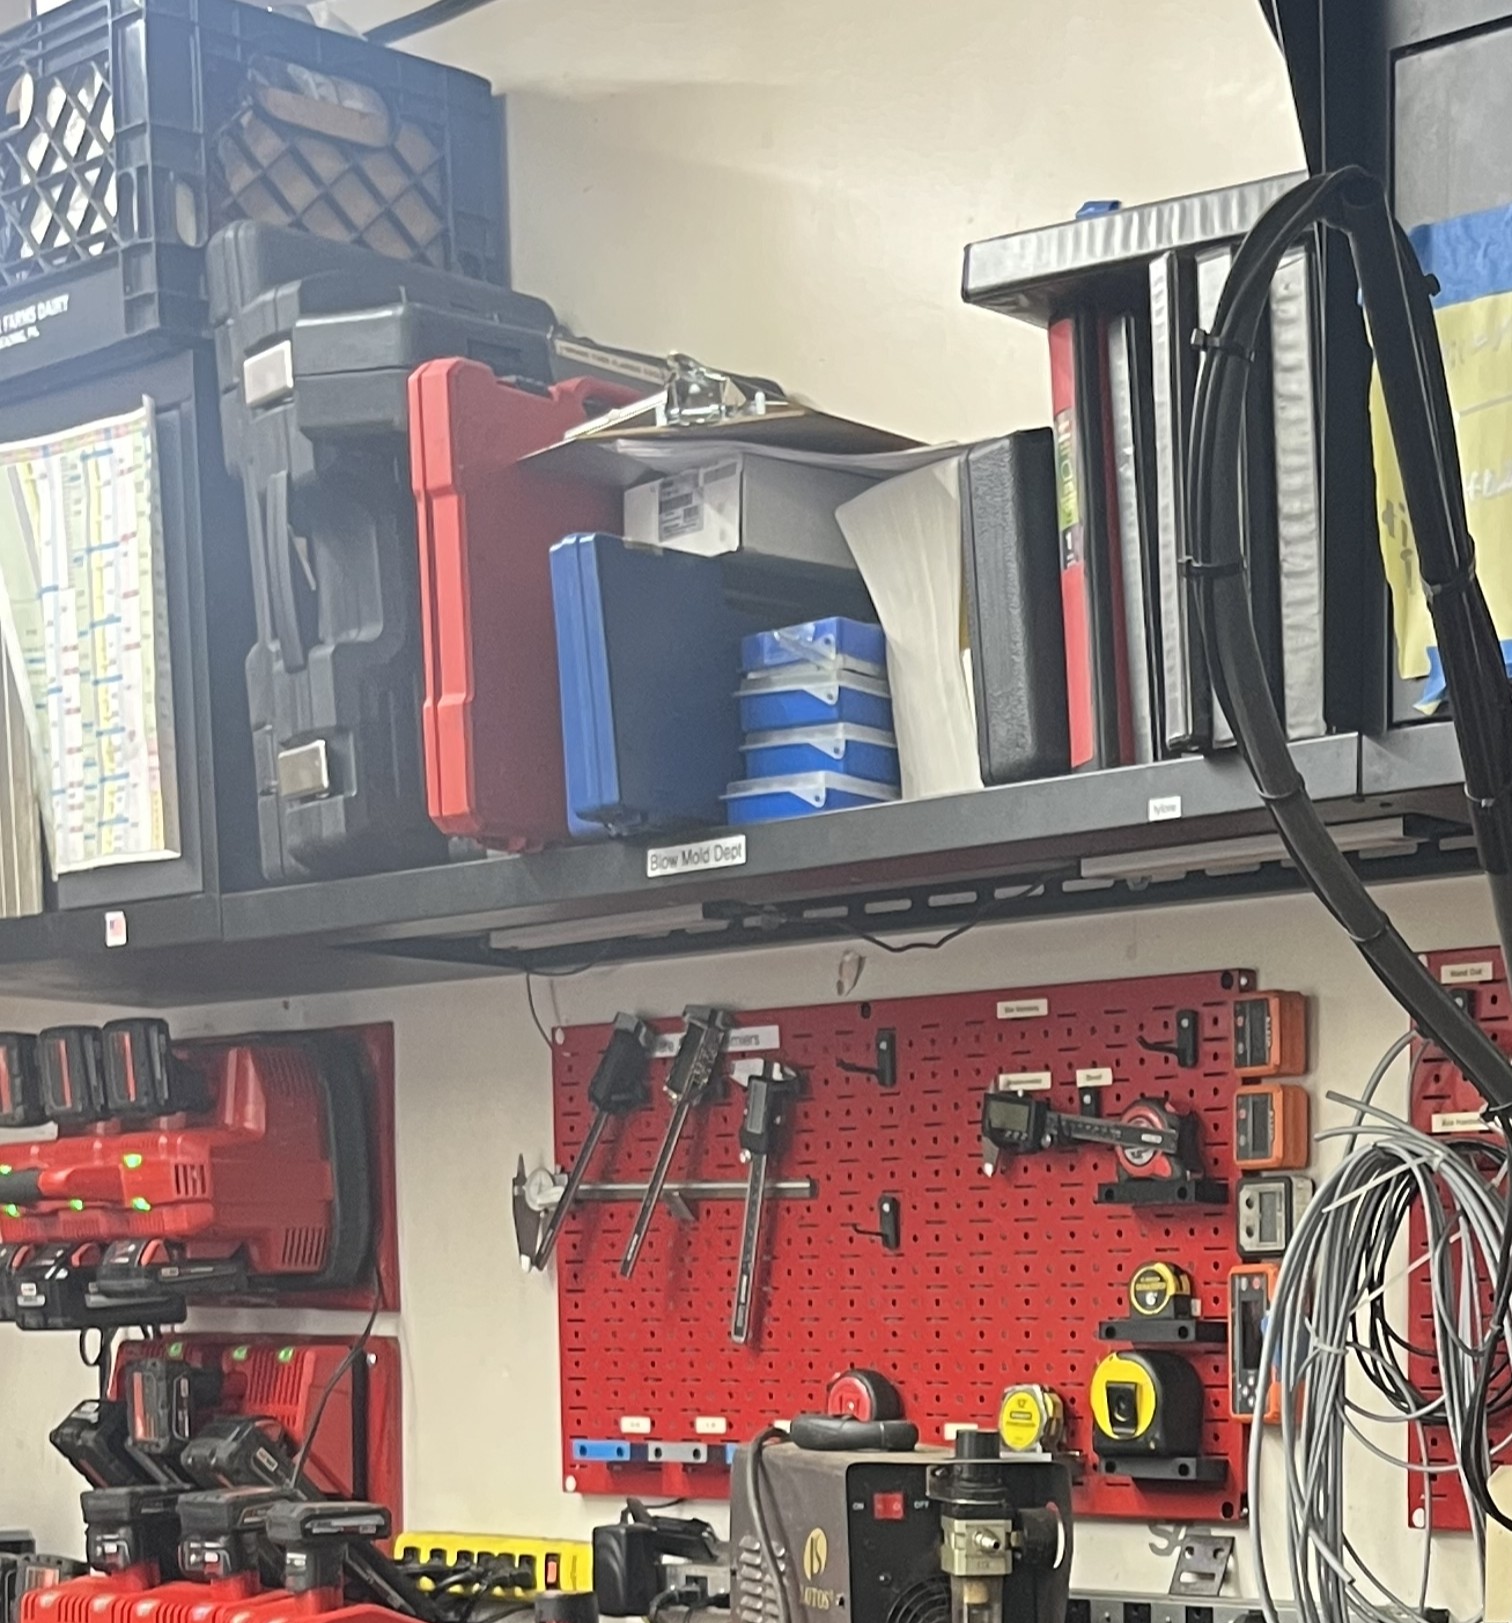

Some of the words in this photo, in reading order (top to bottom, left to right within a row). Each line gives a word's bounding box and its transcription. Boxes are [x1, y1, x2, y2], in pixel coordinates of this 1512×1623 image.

[650, 854, 679, 872] Blow
[682, 847, 710, 866] Mold
[714, 843, 742, 862] Dept
